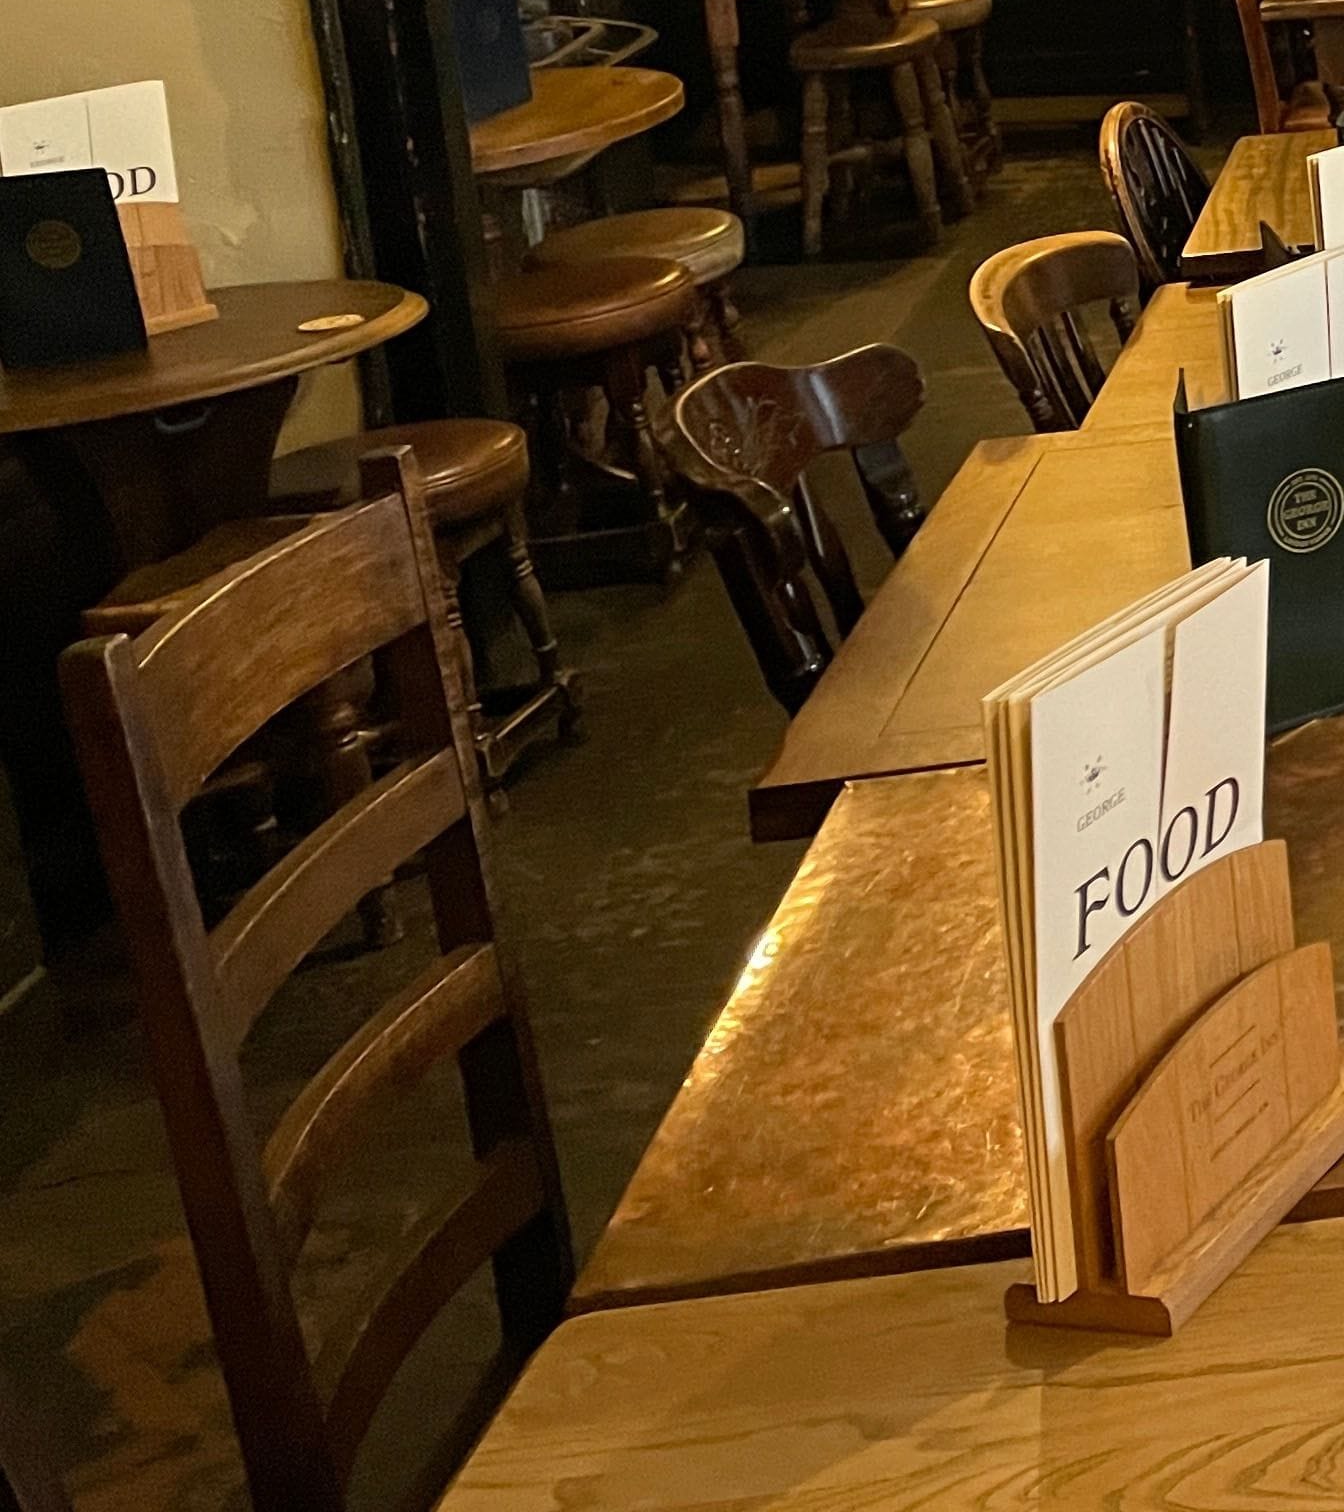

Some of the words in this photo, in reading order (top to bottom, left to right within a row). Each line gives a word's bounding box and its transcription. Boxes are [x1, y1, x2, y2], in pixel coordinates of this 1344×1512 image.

[106, 166, 157, 200] OD
[1267, 363, 1304, 387] GEORGE
[1282, 500, 1331, 521] GEORGE
[1075, 786, 1127, 833] GEORGE
[1071, 776, 1241, 962] FOOD
